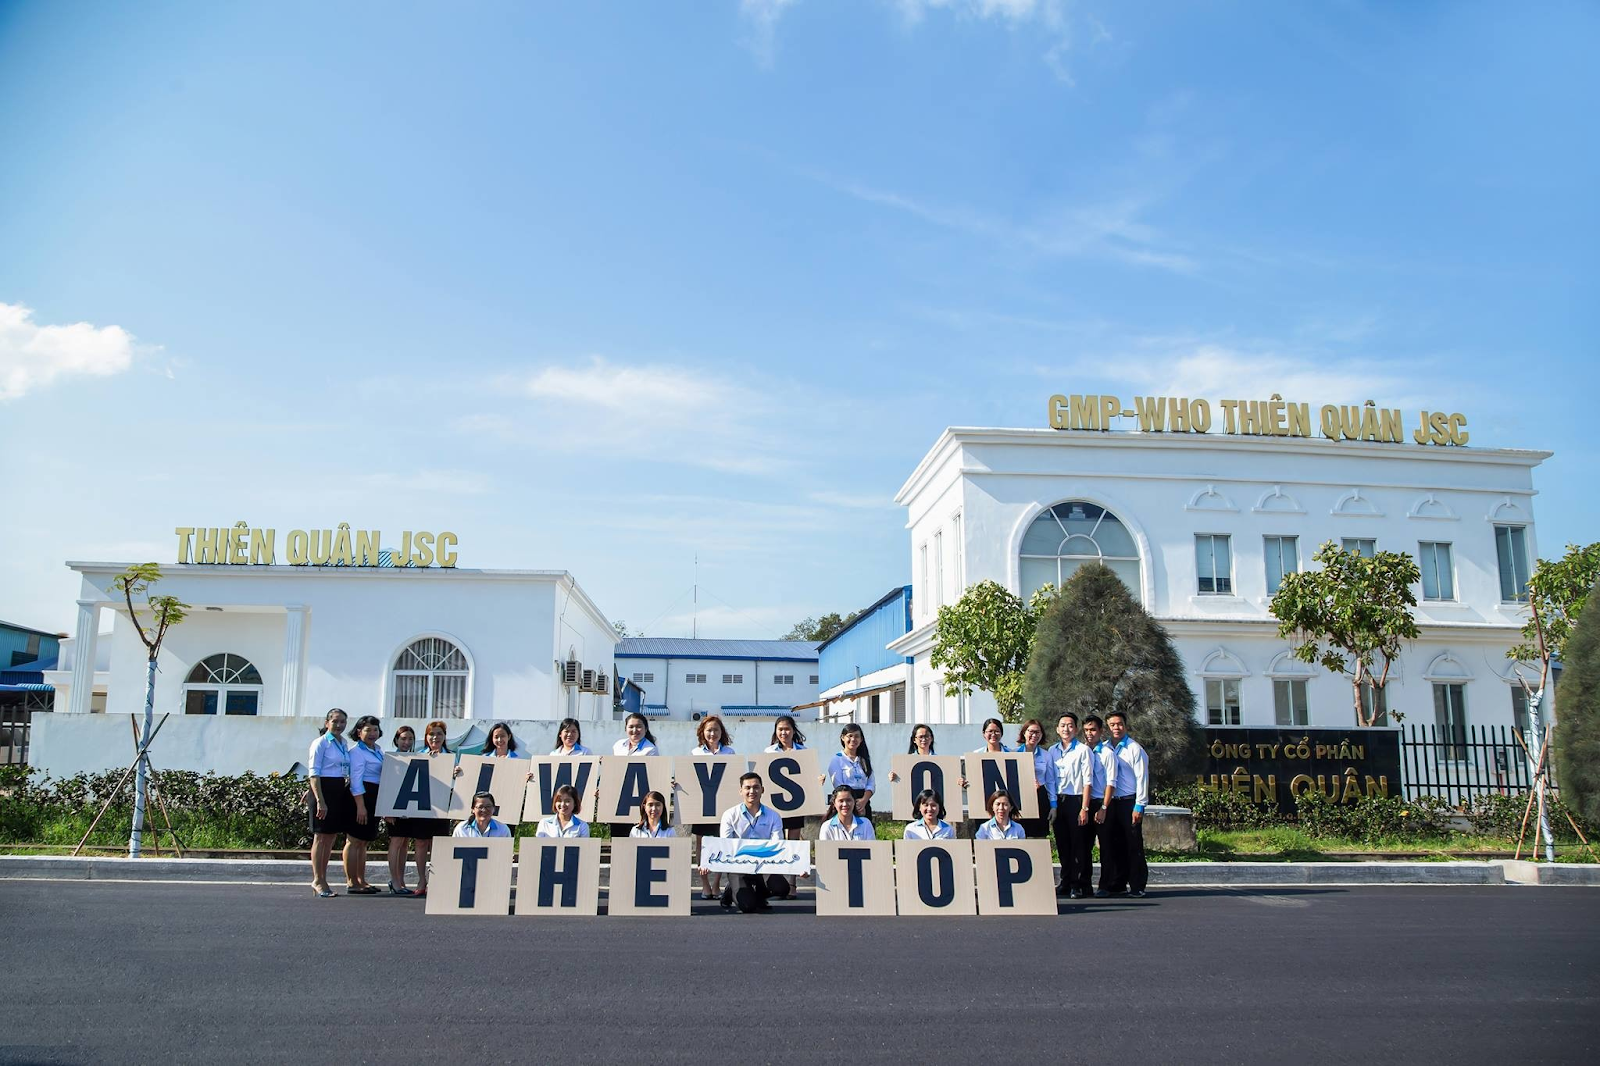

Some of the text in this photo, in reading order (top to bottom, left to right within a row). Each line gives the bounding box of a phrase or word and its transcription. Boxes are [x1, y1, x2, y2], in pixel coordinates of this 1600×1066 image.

[1048, 393, 1470, 447] GMP-WHO THIÊN QUÂN JSC
[175, 520, 458, 568] THIÊN QUÂN JSC
[1206, 739, 1252, 760] ÔNG
[1255, 743, 1279, 760] TY
[1284, 735, 1311, 760] CỔ
[911, 758, 1022, 812] ON
[1196, 766, 1277, 804] HIÊN
[453, 845, 1033, 908] THE TOP
